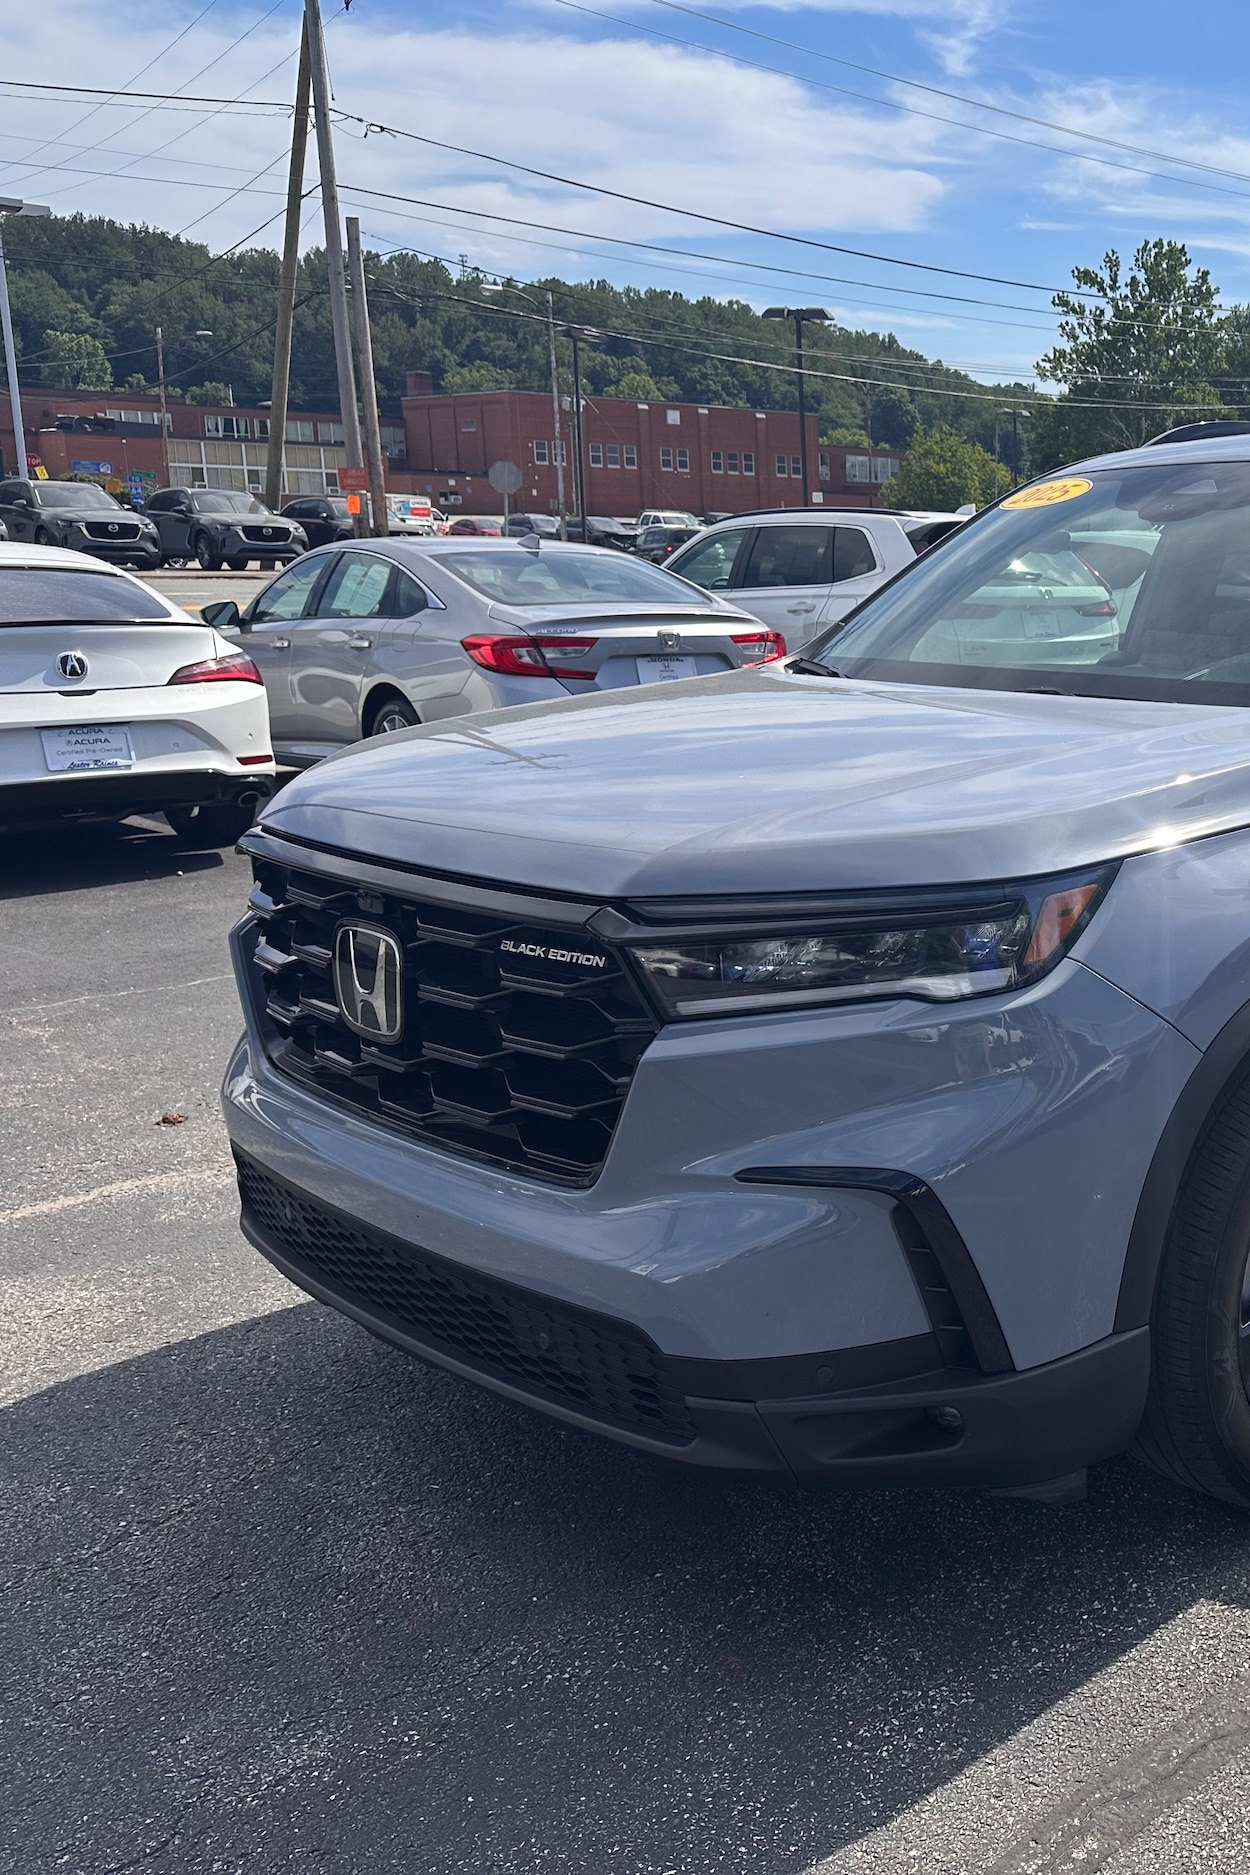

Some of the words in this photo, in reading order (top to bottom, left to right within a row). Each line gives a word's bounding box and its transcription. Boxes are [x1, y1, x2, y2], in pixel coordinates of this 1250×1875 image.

[1007, 483, 1084, 505] 2025
[68, 728, 104, 736] ACURA
[73, 738, 111, 746] ACURA
[56, 748, 84, 756] Certified
[86, 747, 123, 755] Pre-Owned
[500, 940, 547, 958] BLACK
[548, 948, 606, 968] EDITION
